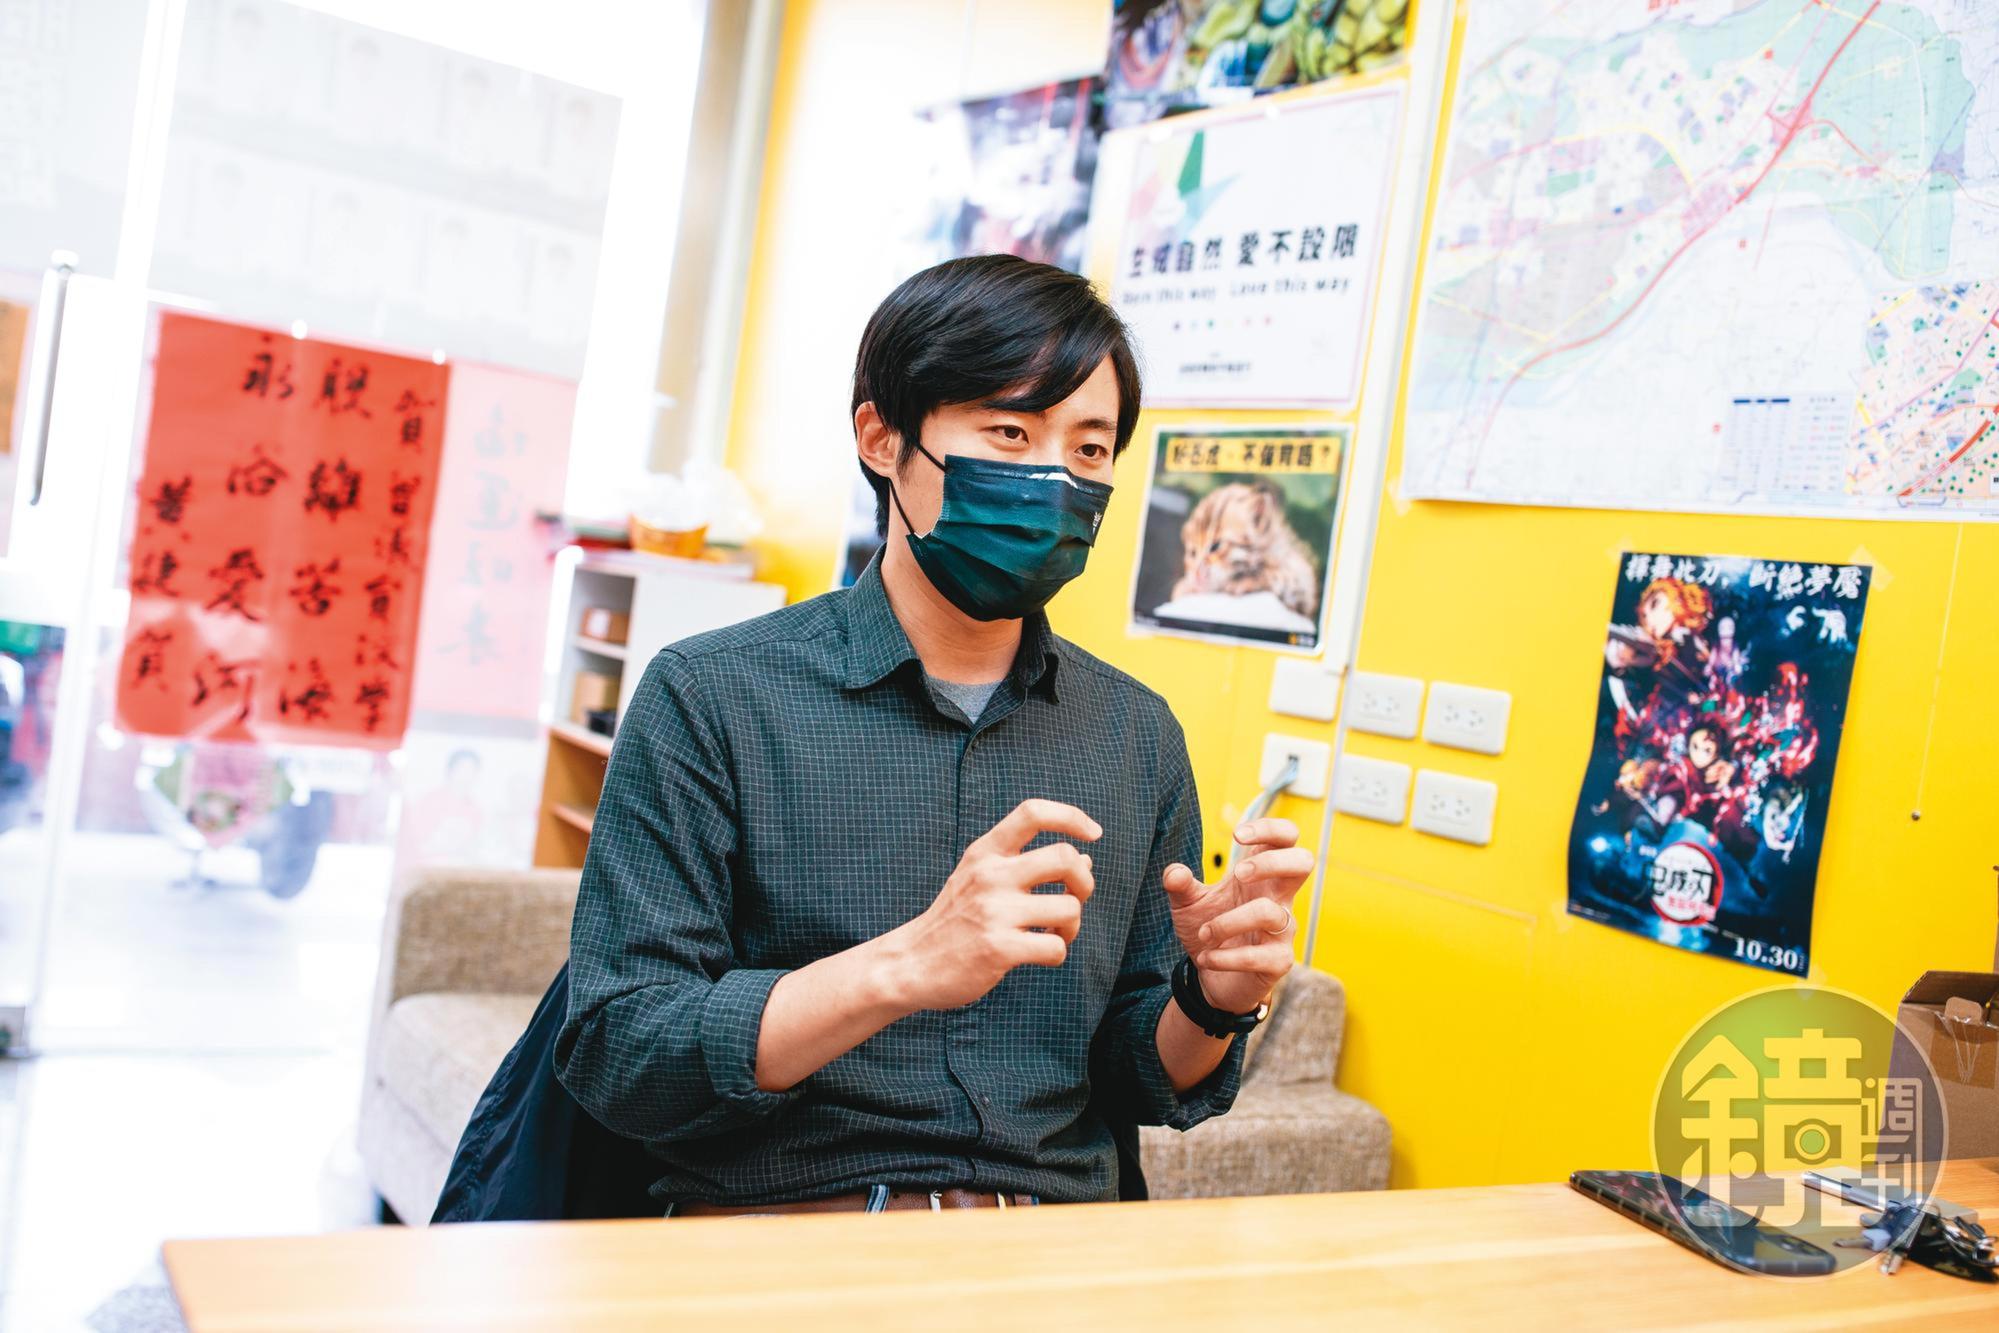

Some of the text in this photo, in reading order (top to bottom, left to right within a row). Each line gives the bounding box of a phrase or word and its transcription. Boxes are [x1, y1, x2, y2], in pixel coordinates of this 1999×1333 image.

[1238, 223, 1358, 268] 愛不設限
[1315, 276, 1350, 295] way
[1734, 937, 1798, 970] 10.30
